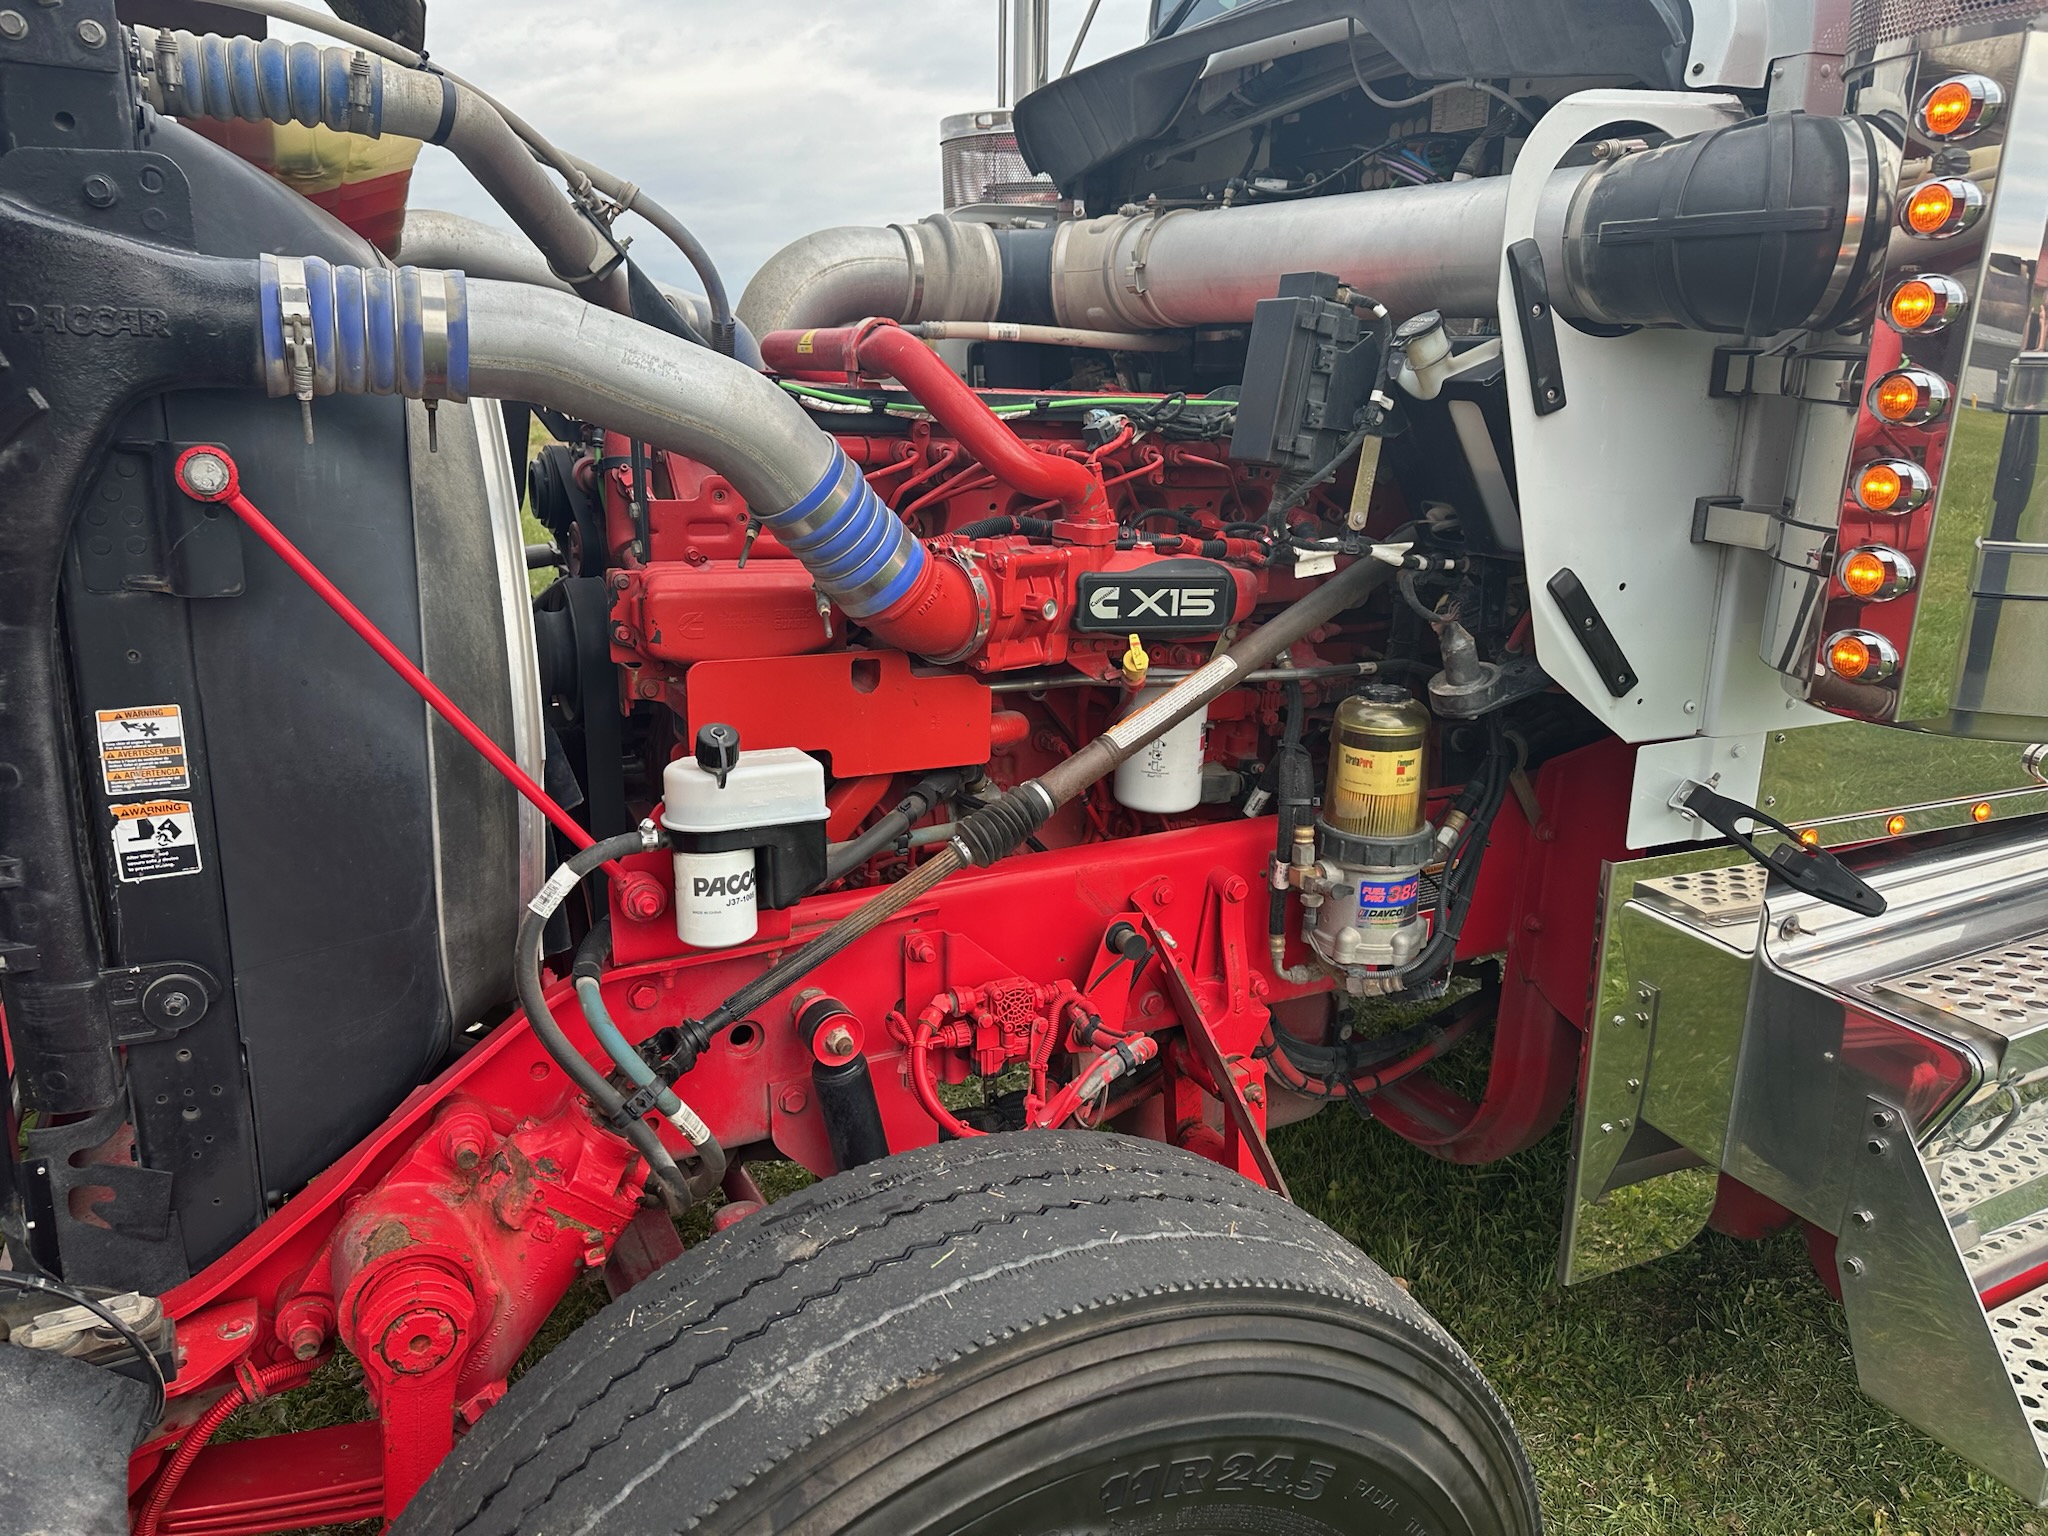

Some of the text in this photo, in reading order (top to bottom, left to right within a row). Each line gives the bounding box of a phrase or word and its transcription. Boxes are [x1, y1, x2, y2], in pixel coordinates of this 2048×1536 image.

[8, 303, 171, 337] PACCAR
[1127, 588, 1216, 617] X15
[124, 709, 164, 718] WARNING
[118, 749, 180, 758] AVERTISSEMENT
[129, 803, 181, 816] WARNING
[694, 867, 756, 896] PACCA
[1362, 886, 1386, 895] FUEL
[1388, 882, 1418, 903] 382
[1364, 894, 1385, 902] PRO
[1368, 909, 1402, 917] DAVCO
